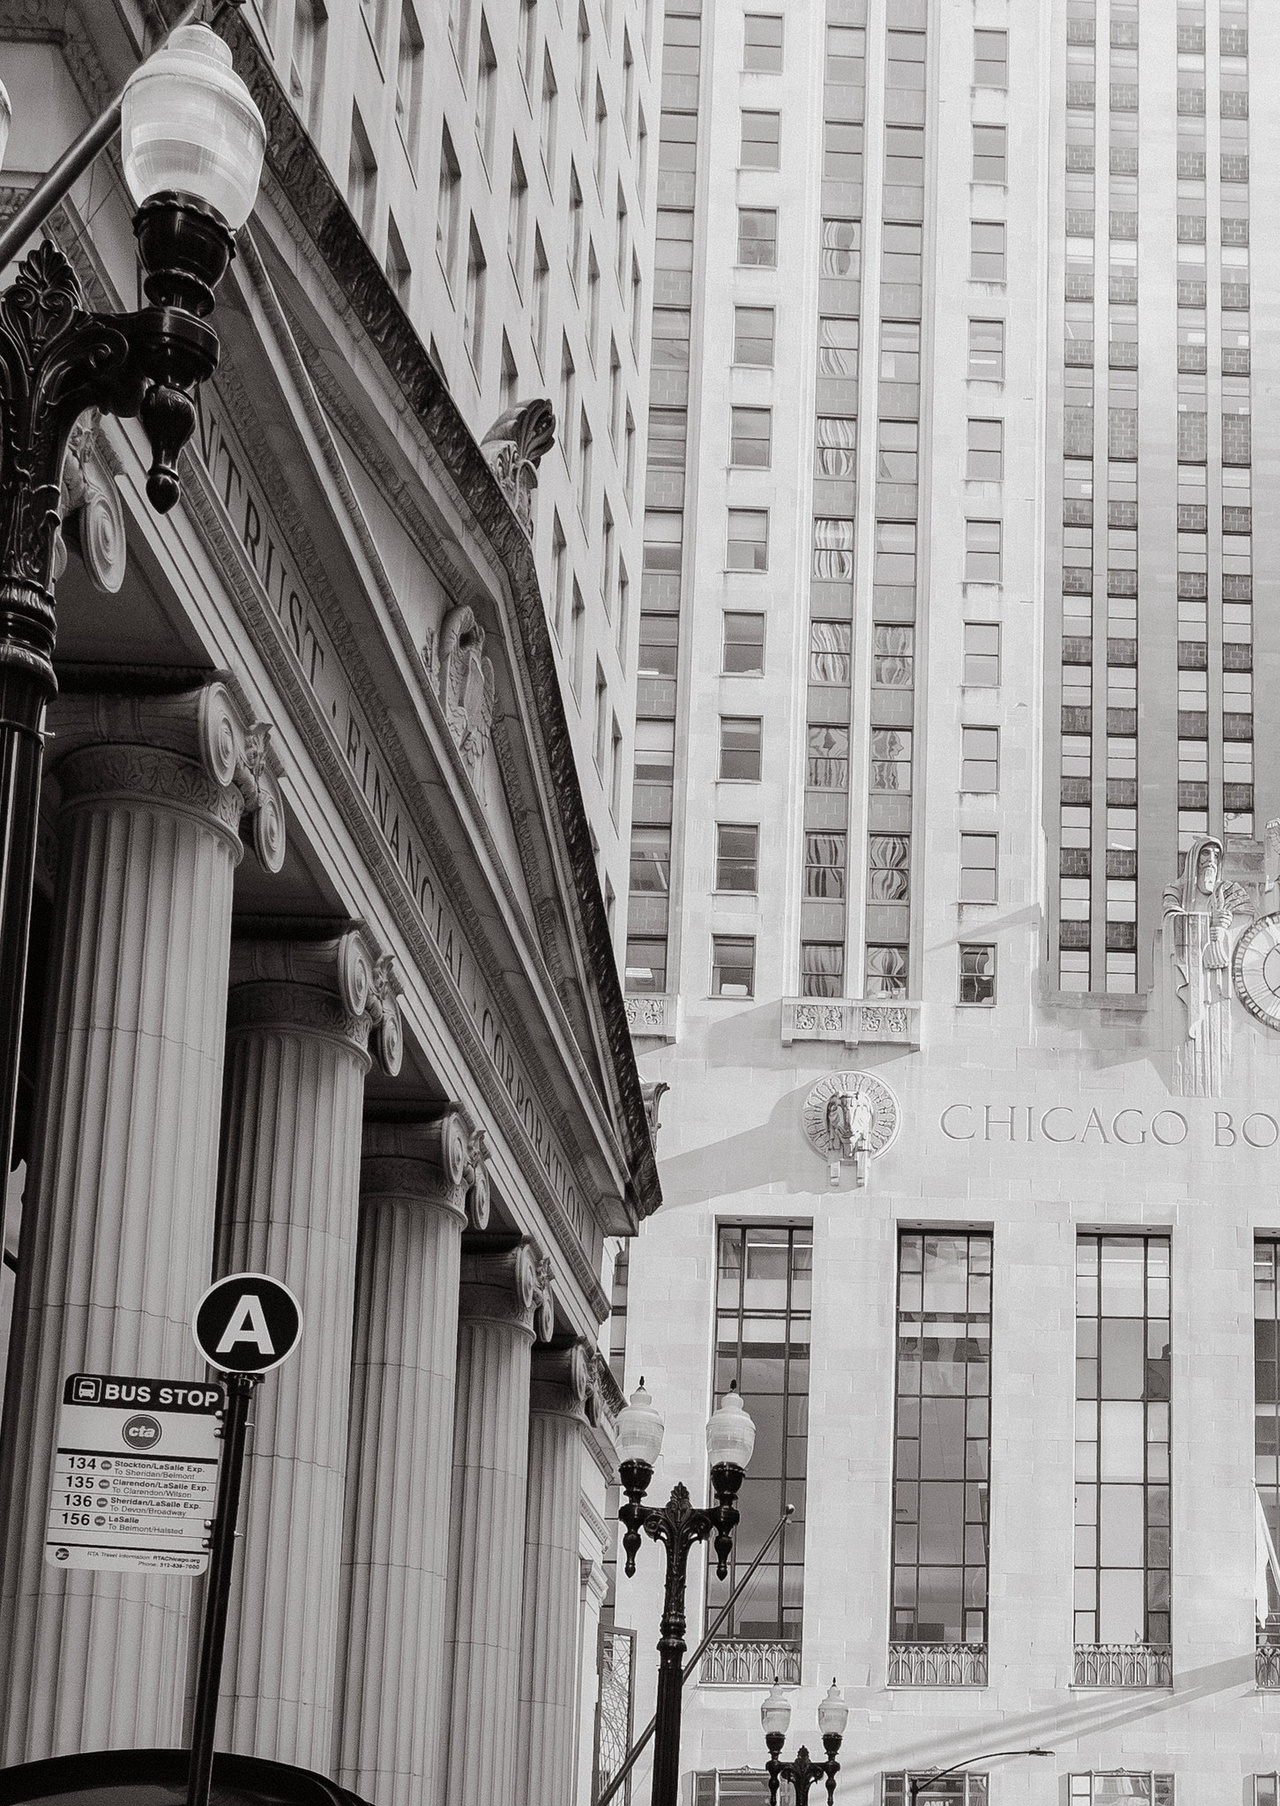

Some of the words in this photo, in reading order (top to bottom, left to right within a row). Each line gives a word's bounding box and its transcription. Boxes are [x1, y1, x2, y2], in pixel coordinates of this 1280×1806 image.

[198, 386, 324, 688] NTRUST
[940, 1103, 1189, 1145] CHICAGO
[215, 1295, 275, 1355] A
[105, 1384, 151, 1402] BUS
[159, 1388, 219, 1407] STOP
[128, 1426, 156, 1438] cta
[68, 1457, 97, 1470] 134
[114, 1461, 185, 1471] Stockton/LaSalle
[187, 1465, 205, 1473] Exp.
[66, 1476, 94, 1489] 135
[112, 1479, 189, 1490] Clarendon/LaSalle
[191, 1484, 209, 1492] Exp.
[64, 1494, 92, 1507] 136
[110, 1497, 181, 1508] Sheridan/LaSalle
[183, 1502, 202, 1510] Exp.
[62, 1513, 90, 1526] 156
[108, 1516, 139, 1524] LaSalle
